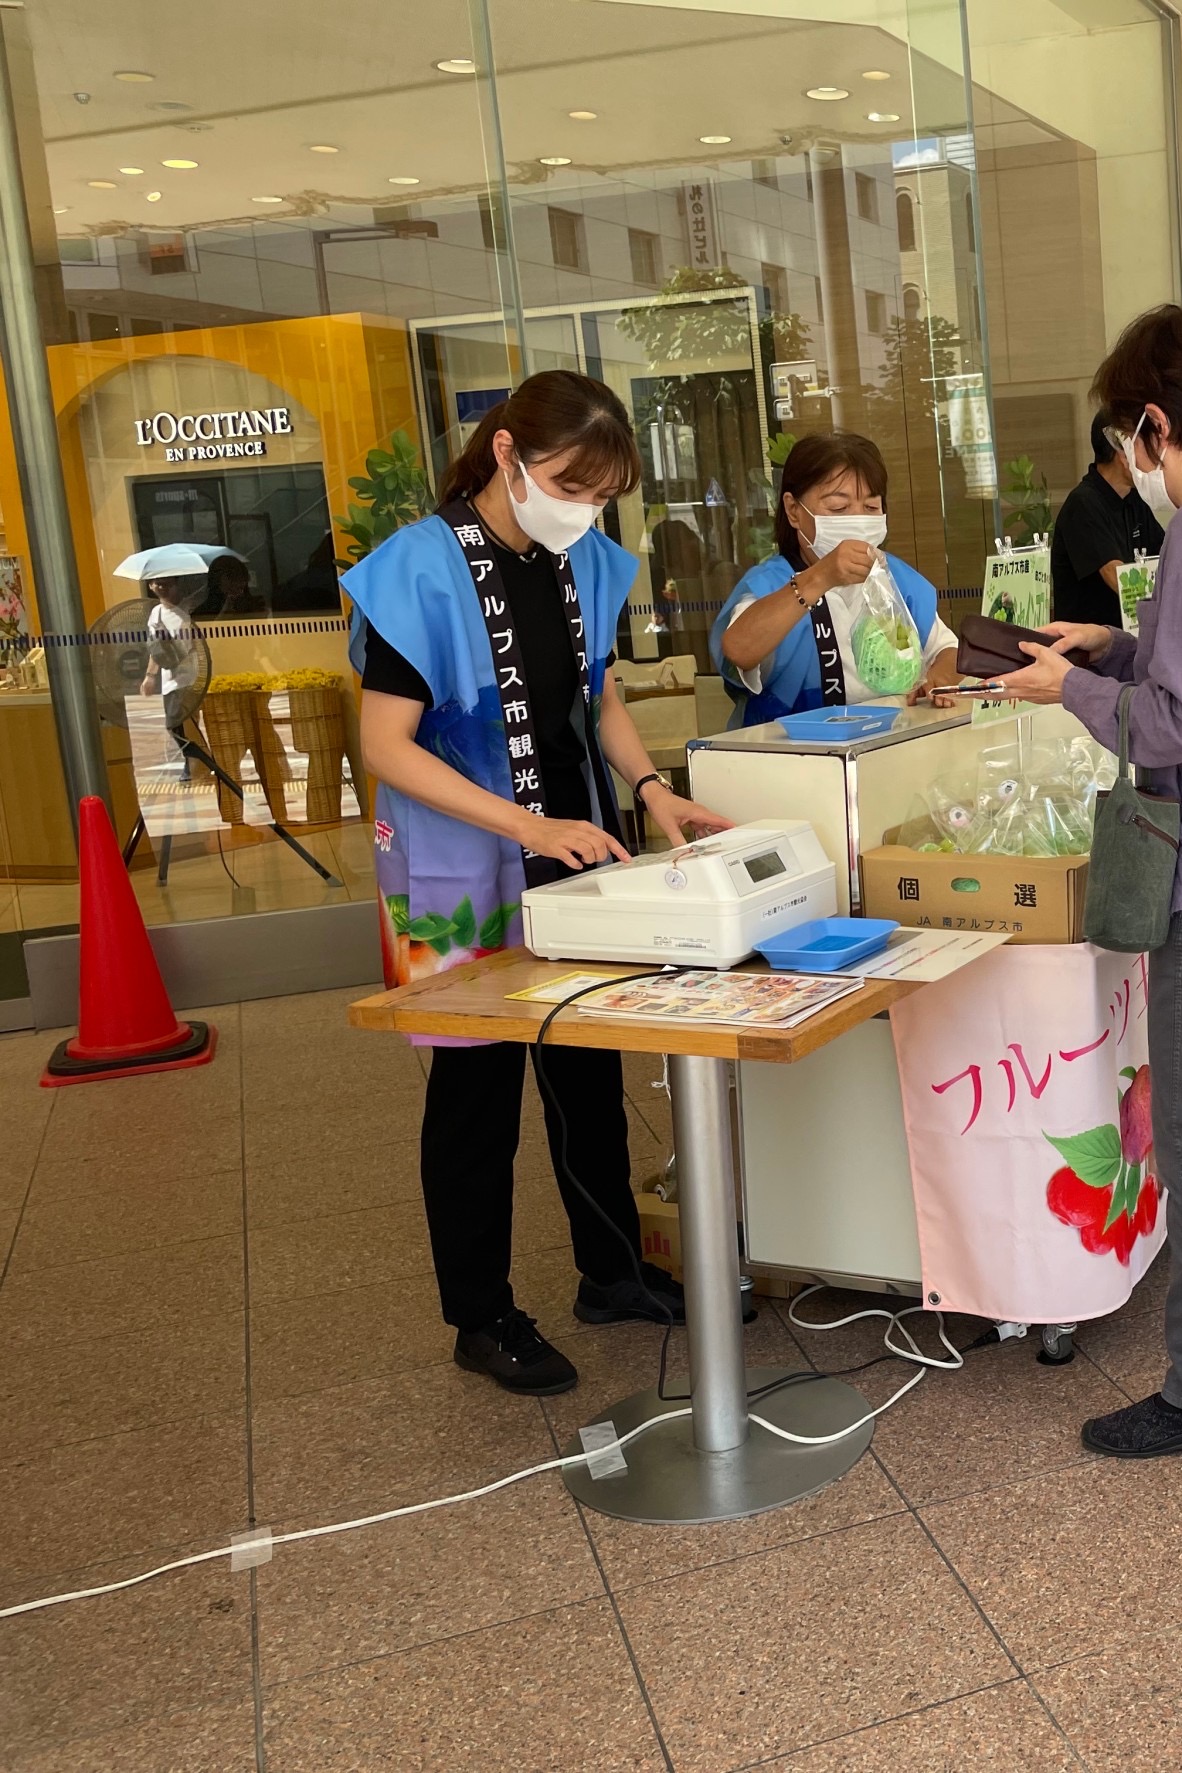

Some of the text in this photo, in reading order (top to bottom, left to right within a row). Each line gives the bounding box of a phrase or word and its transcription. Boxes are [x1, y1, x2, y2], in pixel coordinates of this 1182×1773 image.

[166, 440, 265, 463] EN PROVENCE
[991, 559, 1030, 579] 南アルプス市産
[453, 523, 546, 858] 南アルプス市観光
[898, 877, 1037, 908] 個 選
[917, 915, 932, 927] JA
